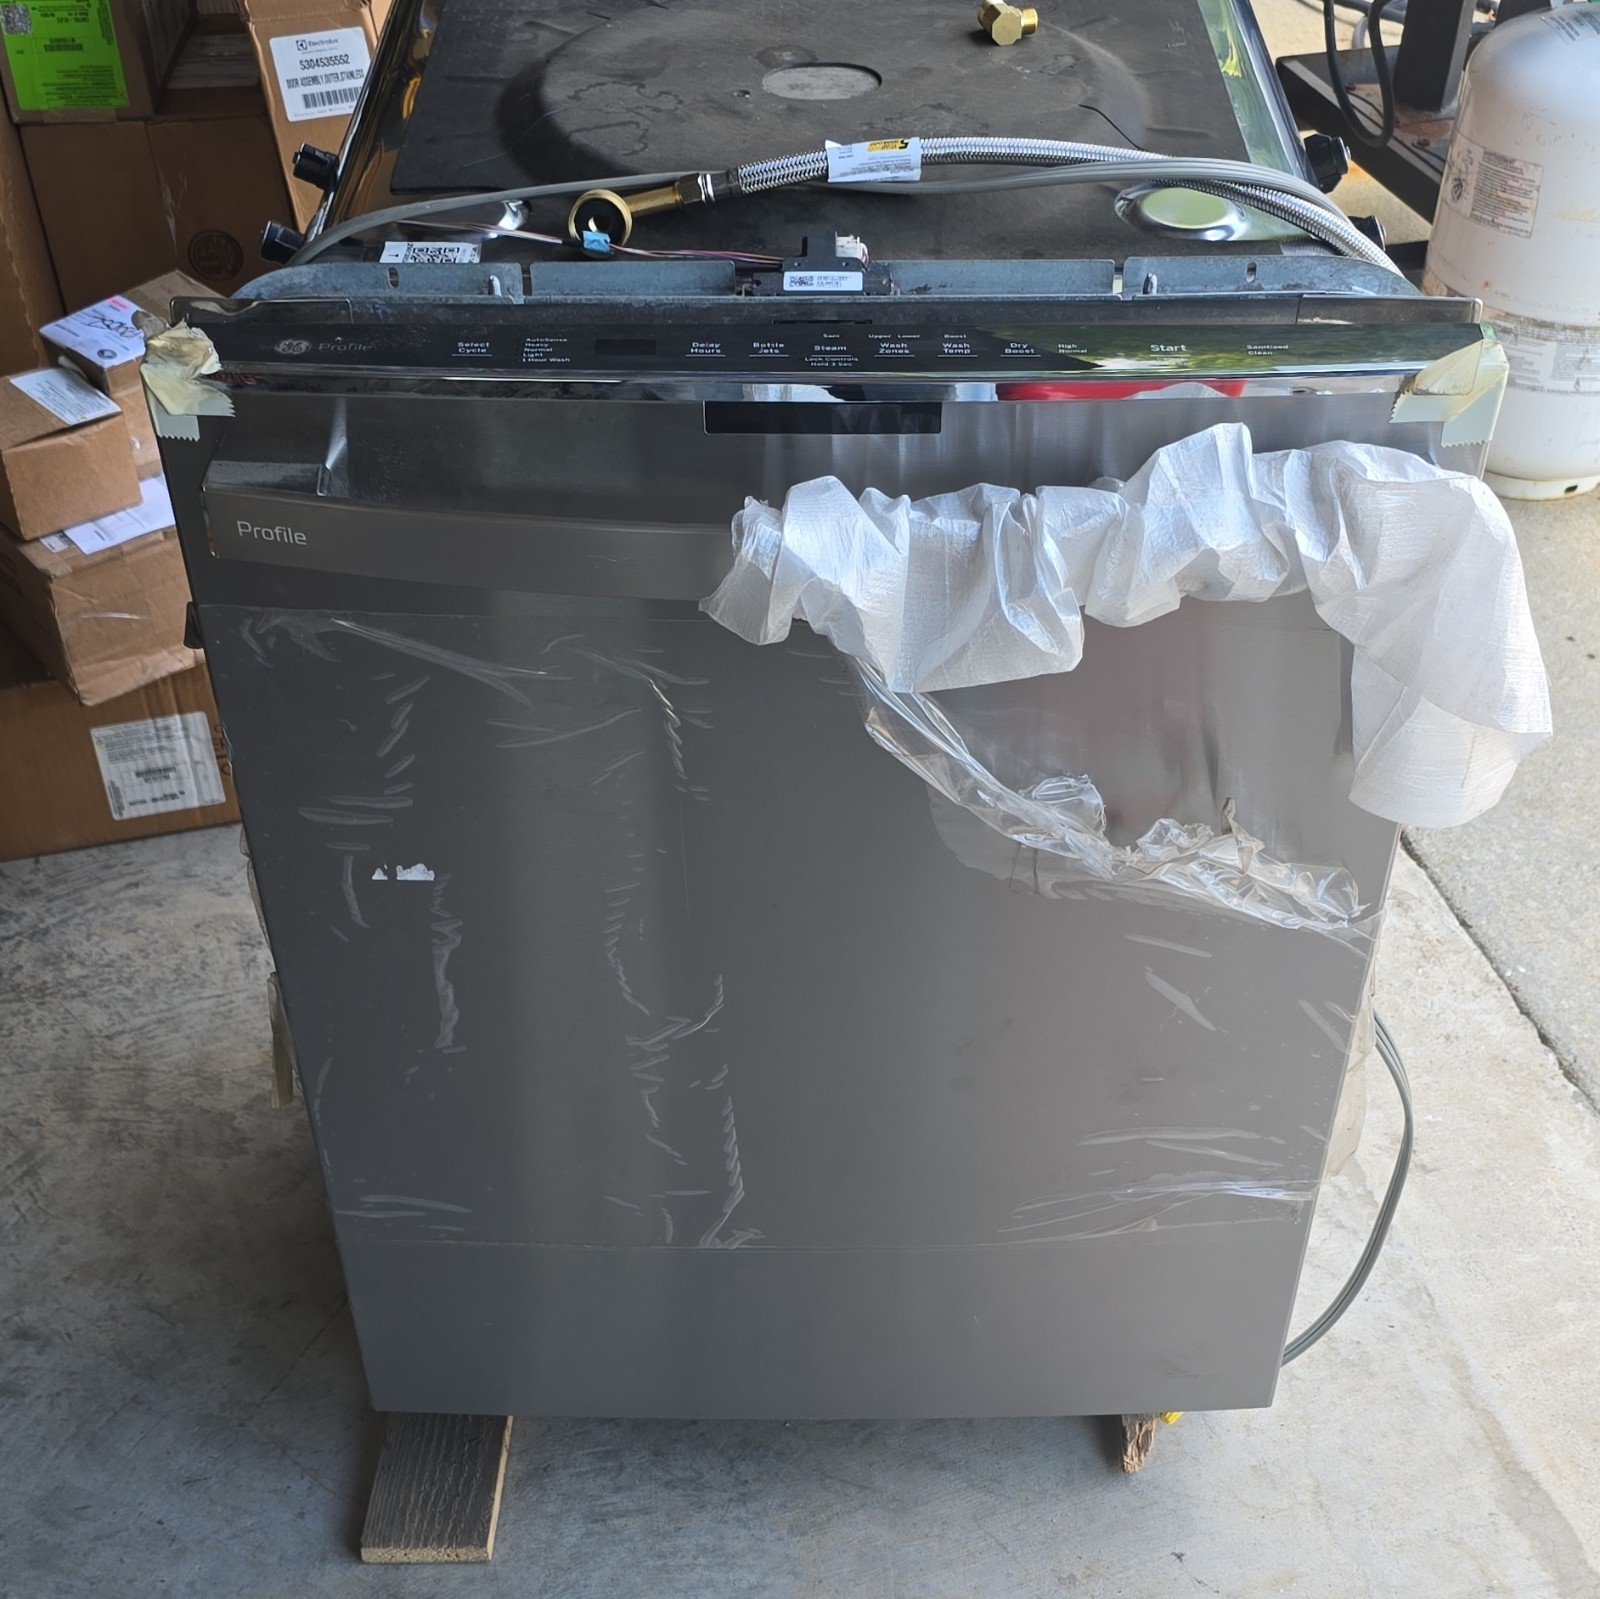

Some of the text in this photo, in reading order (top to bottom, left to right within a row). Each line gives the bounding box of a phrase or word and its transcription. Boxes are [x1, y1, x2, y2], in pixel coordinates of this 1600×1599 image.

[308, 38, 339, 47] Electrolux
[299, 54, 351, 70] 5304535552
[318, 342, 373, 352] Profile
[814, 344, 847, 352] Steam
[942, 347, 971, 355] Temp
[1150, 343, 1188, 352] Start
[236, 520, 308, 546] Profile
